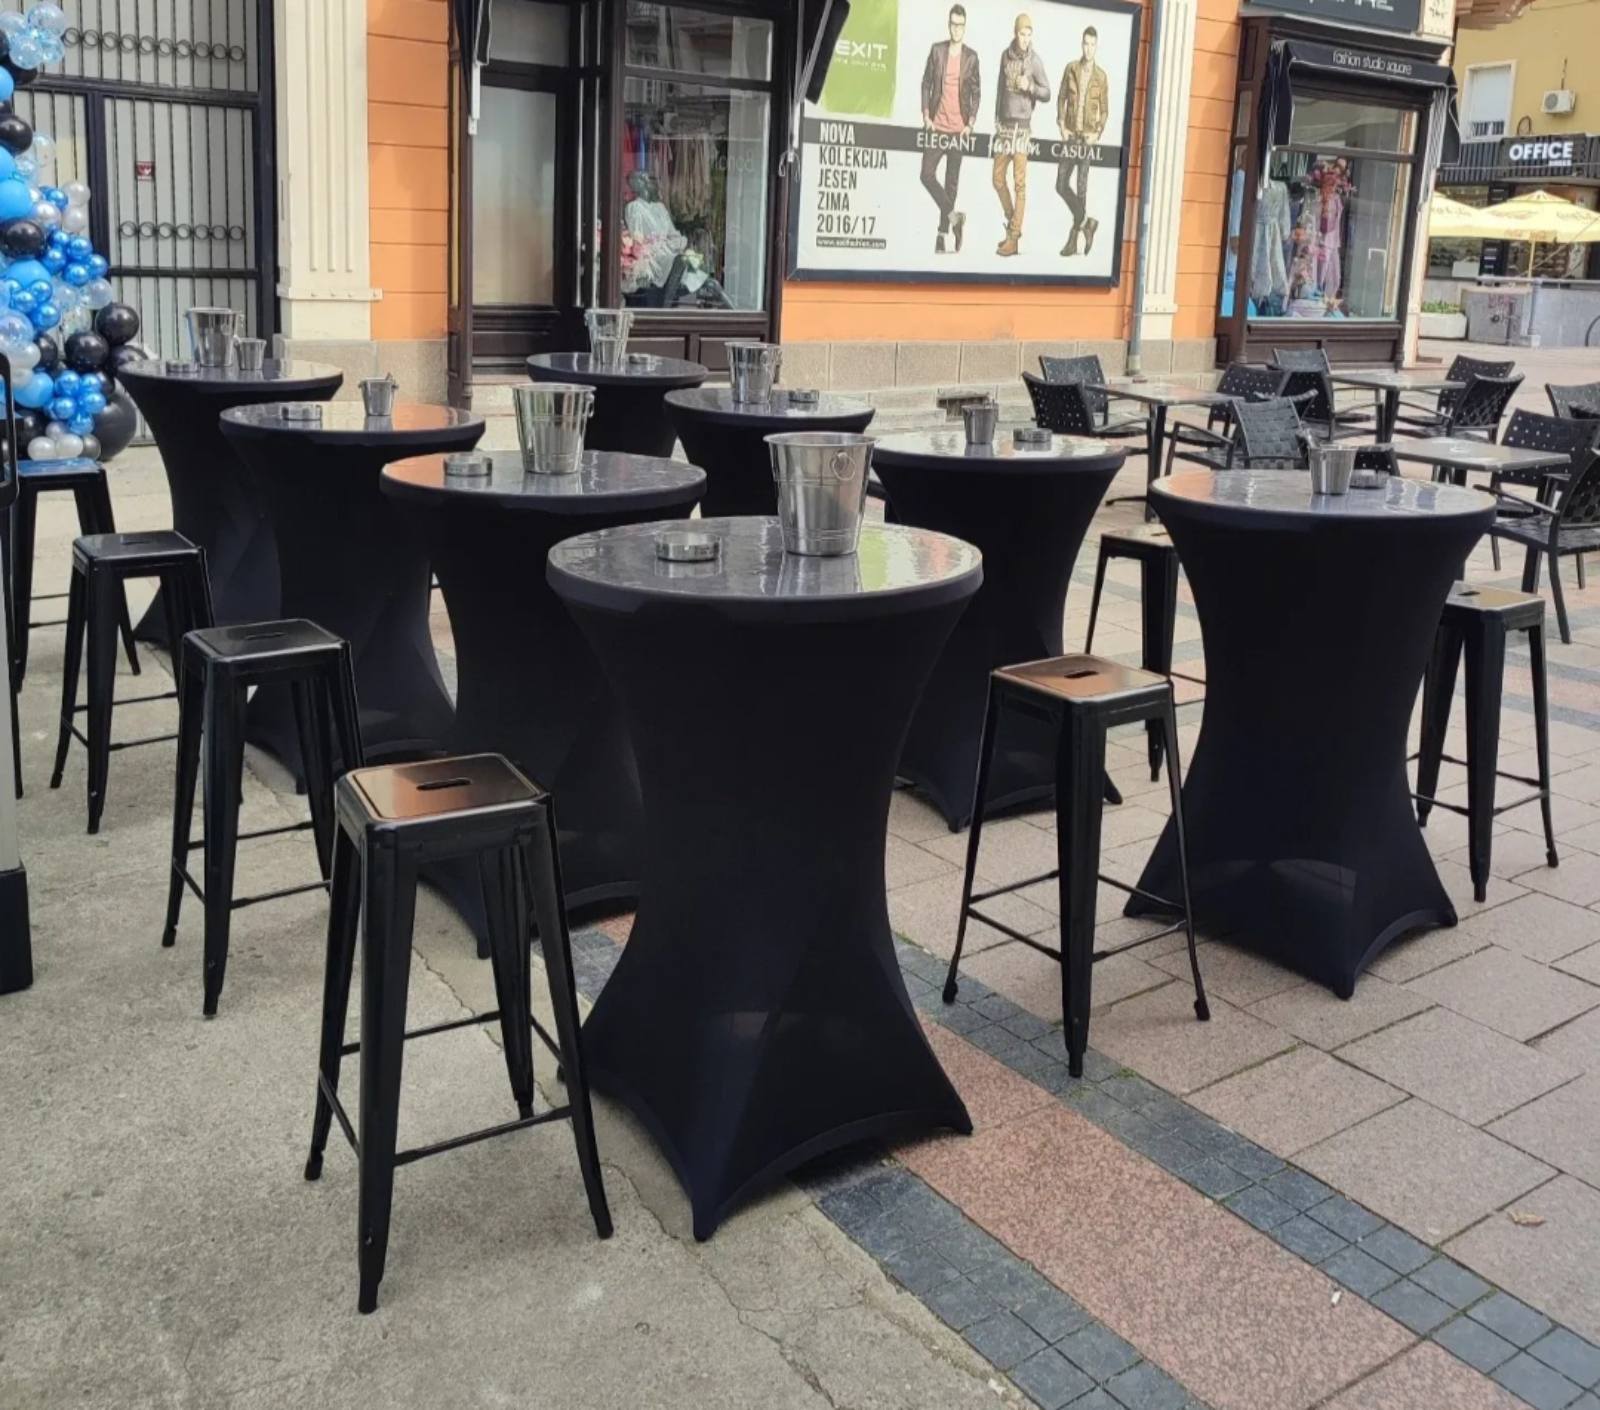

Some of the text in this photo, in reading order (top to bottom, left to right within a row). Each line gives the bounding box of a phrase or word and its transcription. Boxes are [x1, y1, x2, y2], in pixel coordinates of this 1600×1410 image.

[834, 39, 888, 60] EXIT
[1332, 49, 1361, 67] fashion
[1362, 55, 1386, 70] studio
[819, 121, 856, 145] NOVA
[916, 131, 977, 152] ELEGANT
[819, 145, 888, 169] KOLEKCIJA
[1051, 143, 1103, 161] CASUAL
[1508, 141, 1574, 161] OFFICE
[818, 168, 857, 190] JESEN
[817, 190, 850, 211] ZIMA
[816, 213, 876, 235] 2016/17
